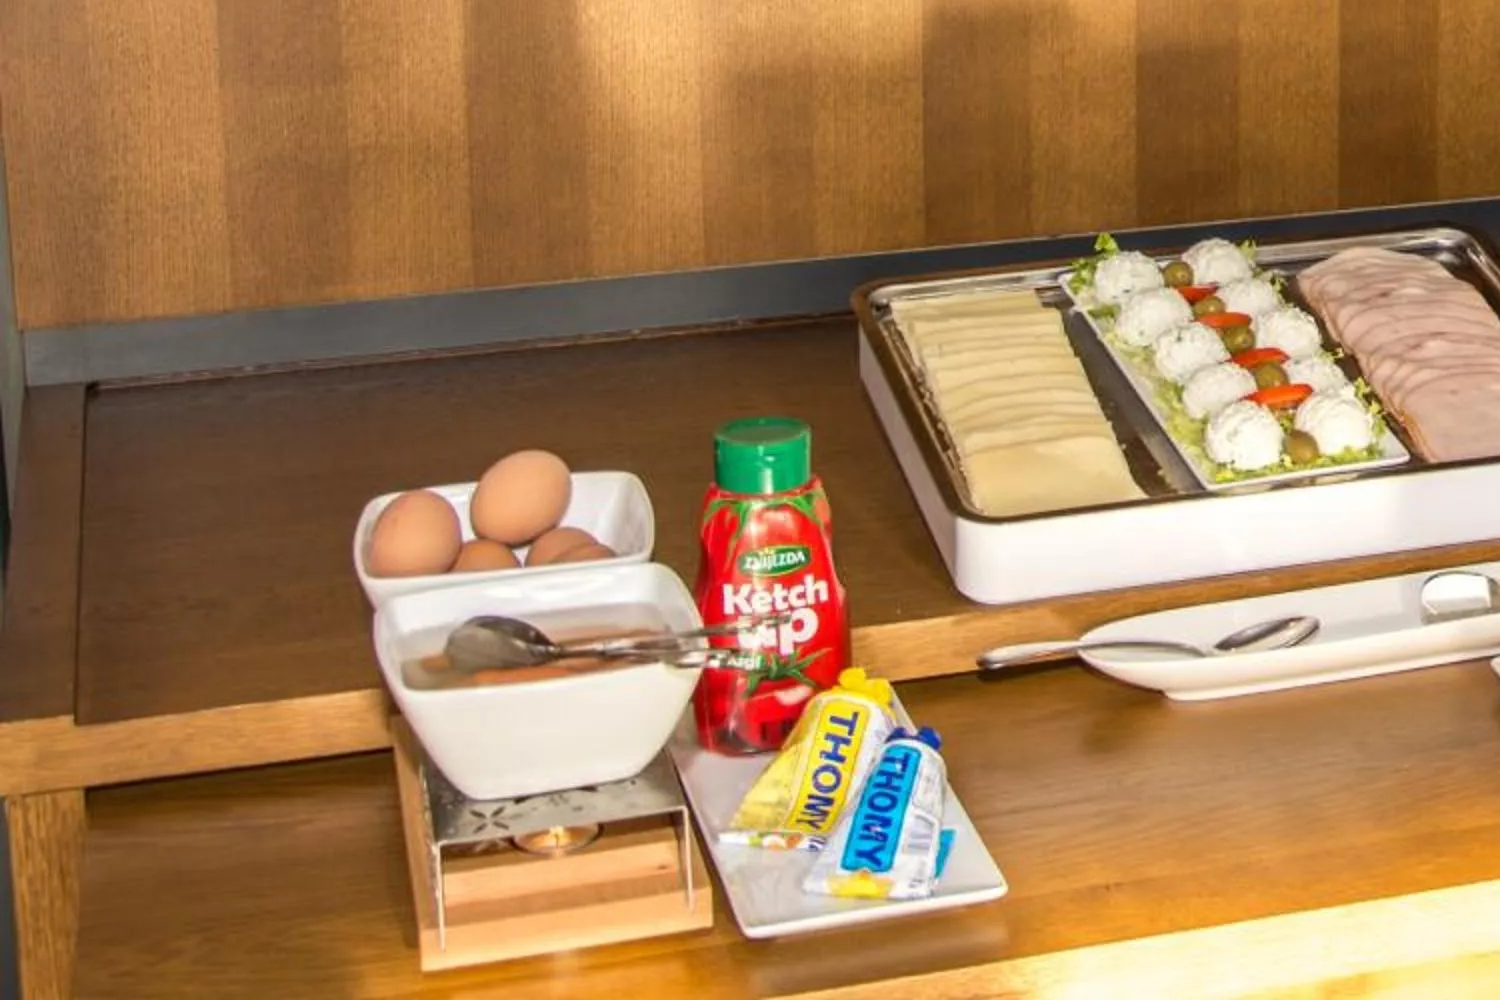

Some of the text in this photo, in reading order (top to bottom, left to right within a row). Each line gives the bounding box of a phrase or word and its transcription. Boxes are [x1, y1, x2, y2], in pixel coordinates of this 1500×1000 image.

[722, 574, 829, 617] Ketch
[737, 607, 819, 656] up
[796, 711, 860, 831] THOMY
[855, 751, 909, 868] THOMY
